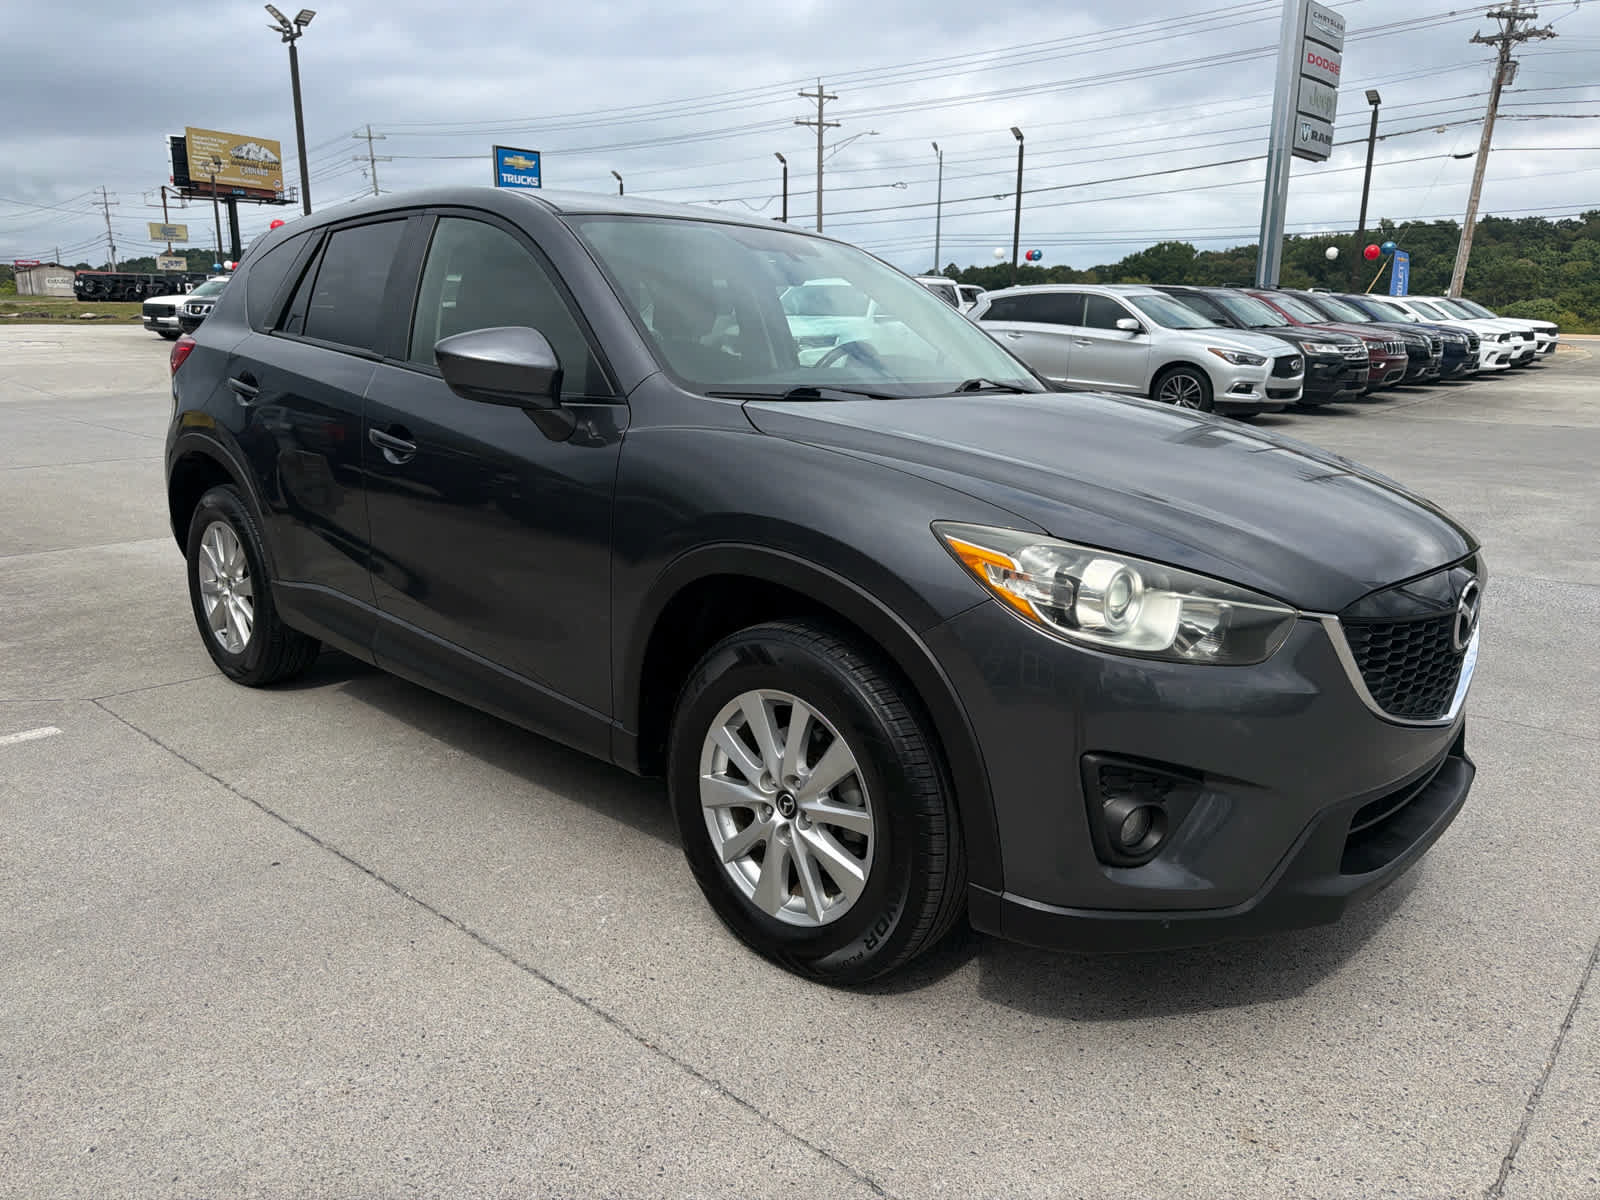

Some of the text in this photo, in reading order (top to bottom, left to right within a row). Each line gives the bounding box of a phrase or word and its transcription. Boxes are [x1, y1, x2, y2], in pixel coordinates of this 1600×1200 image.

[1312, 11, 1344, 31] CHRYSLER
[1307, 52, 1340, 76] DODGE
[502, 173, 539, 186] TRUCKS
